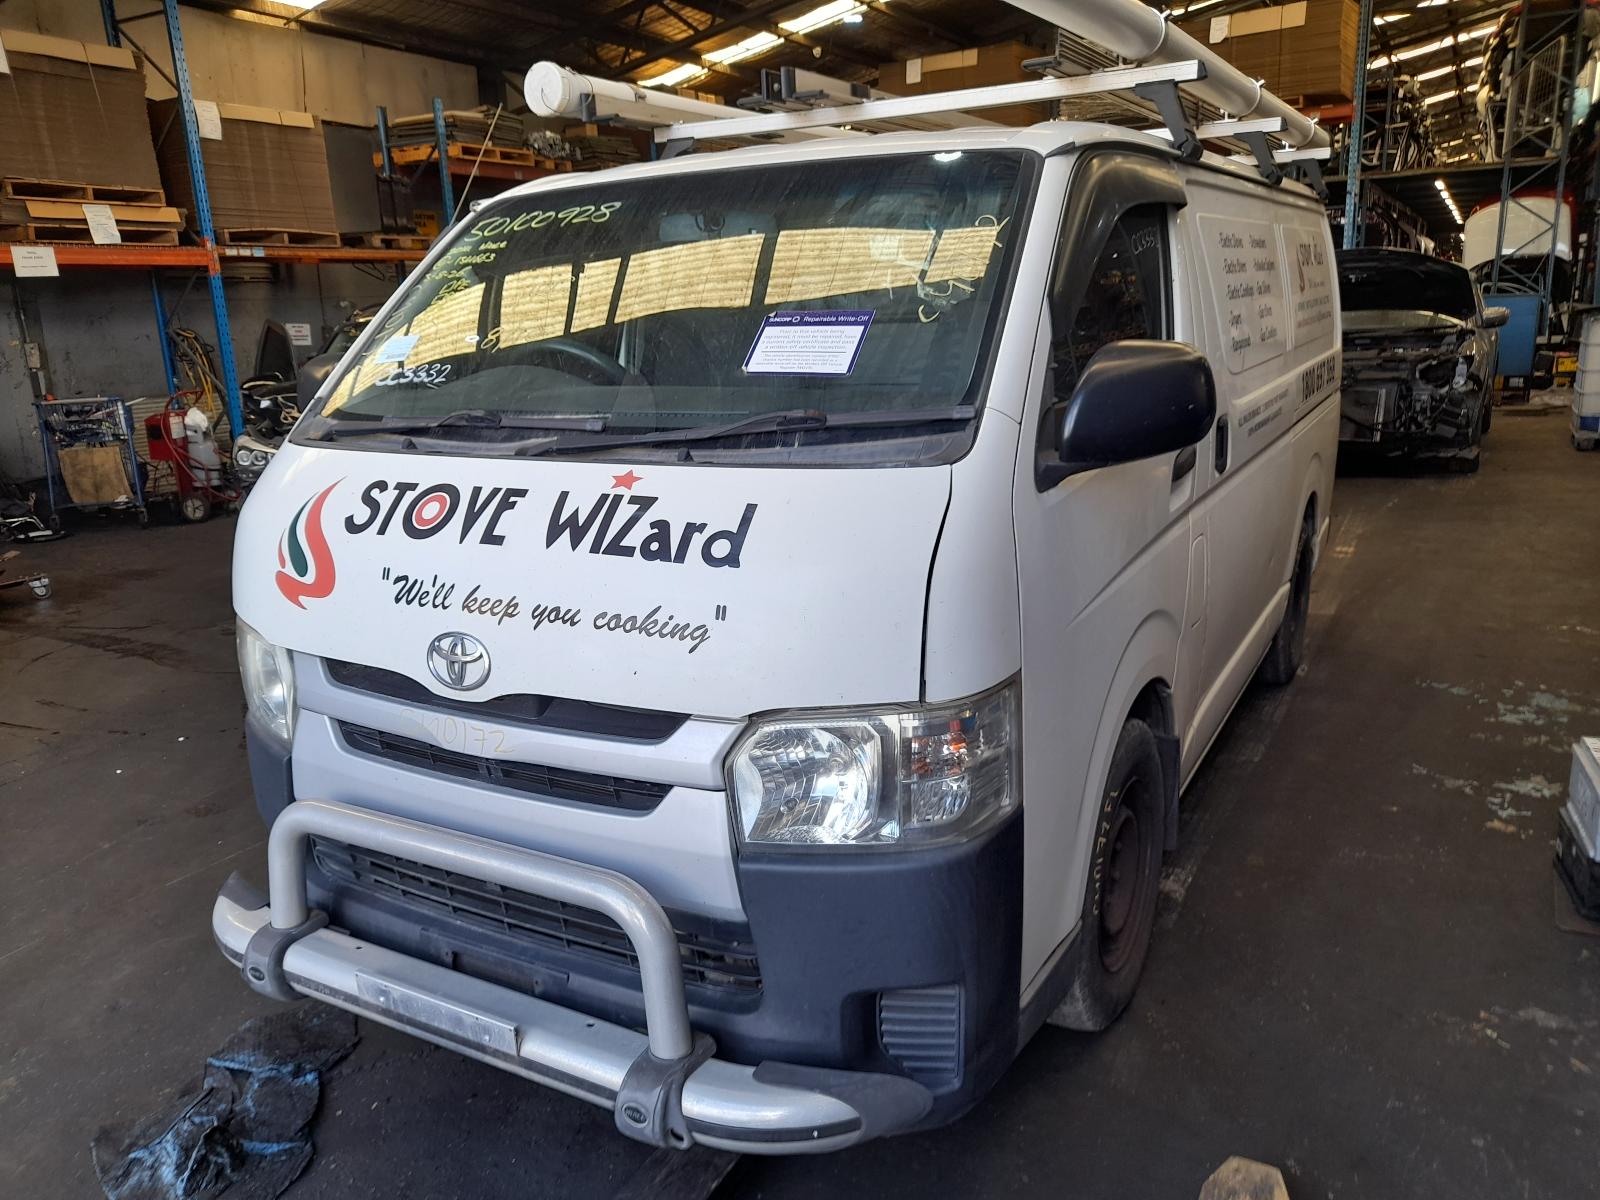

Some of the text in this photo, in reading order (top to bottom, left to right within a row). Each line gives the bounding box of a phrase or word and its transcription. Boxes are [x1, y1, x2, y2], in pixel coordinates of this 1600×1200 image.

[803, 315, 837, 324] Repairable
[838, 314, 870, 322] Write-Off
[344, 479, 758, 569] STOVE WIZard
[461, 584, 521, 627] keep
[530, 601, 582, 631] you
